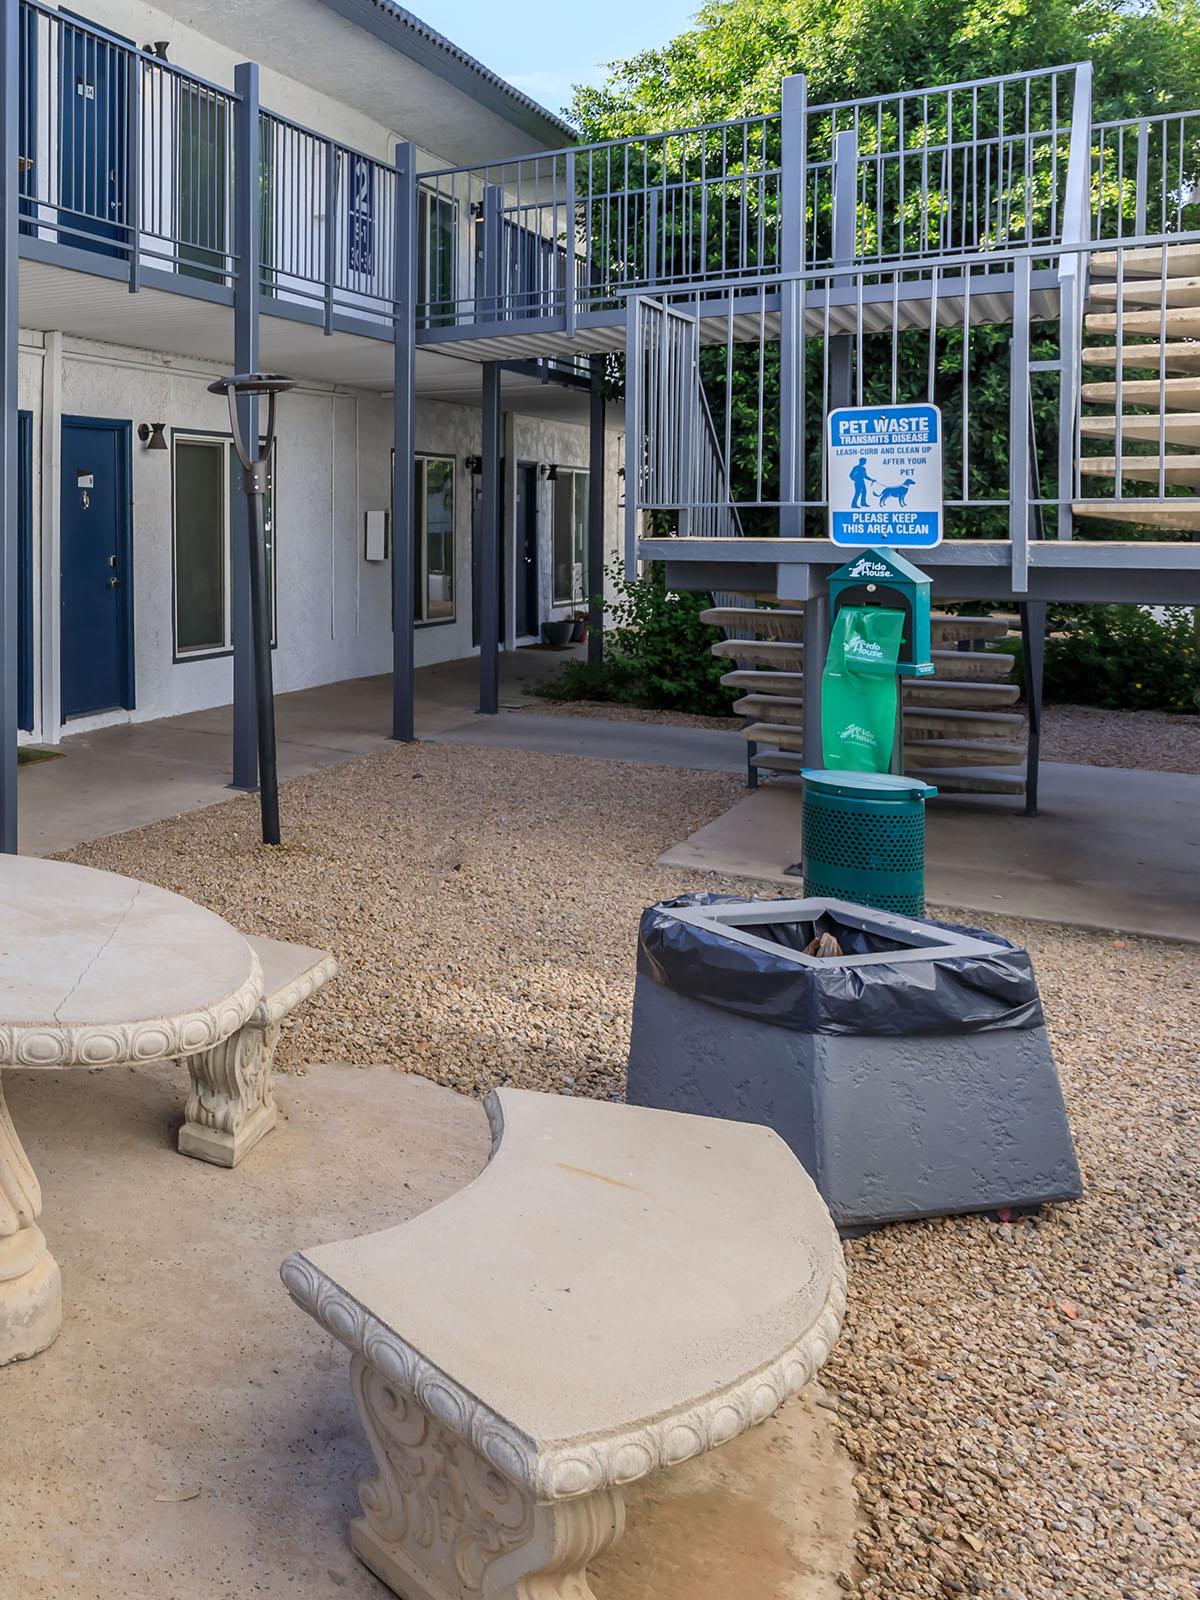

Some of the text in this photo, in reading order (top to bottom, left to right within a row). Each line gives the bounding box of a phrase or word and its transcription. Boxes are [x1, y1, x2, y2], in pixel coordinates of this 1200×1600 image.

[355, 161, 369, 212] 2
[839, 417, 929, 434] PET WASTE
[840, 433, 929, 445] TRANSMITS DISEASE
[836, 448, 878, 456] LEASH-CURB
[906, 457, 927, 465] YOUR
[900, 468, 915, 476] PET
[852, 513, 918, 523] PLEASE KEEP
[842, 523, 929, 535] THIS AREA CLEAN
[865, 561, 887, 571] Fido
